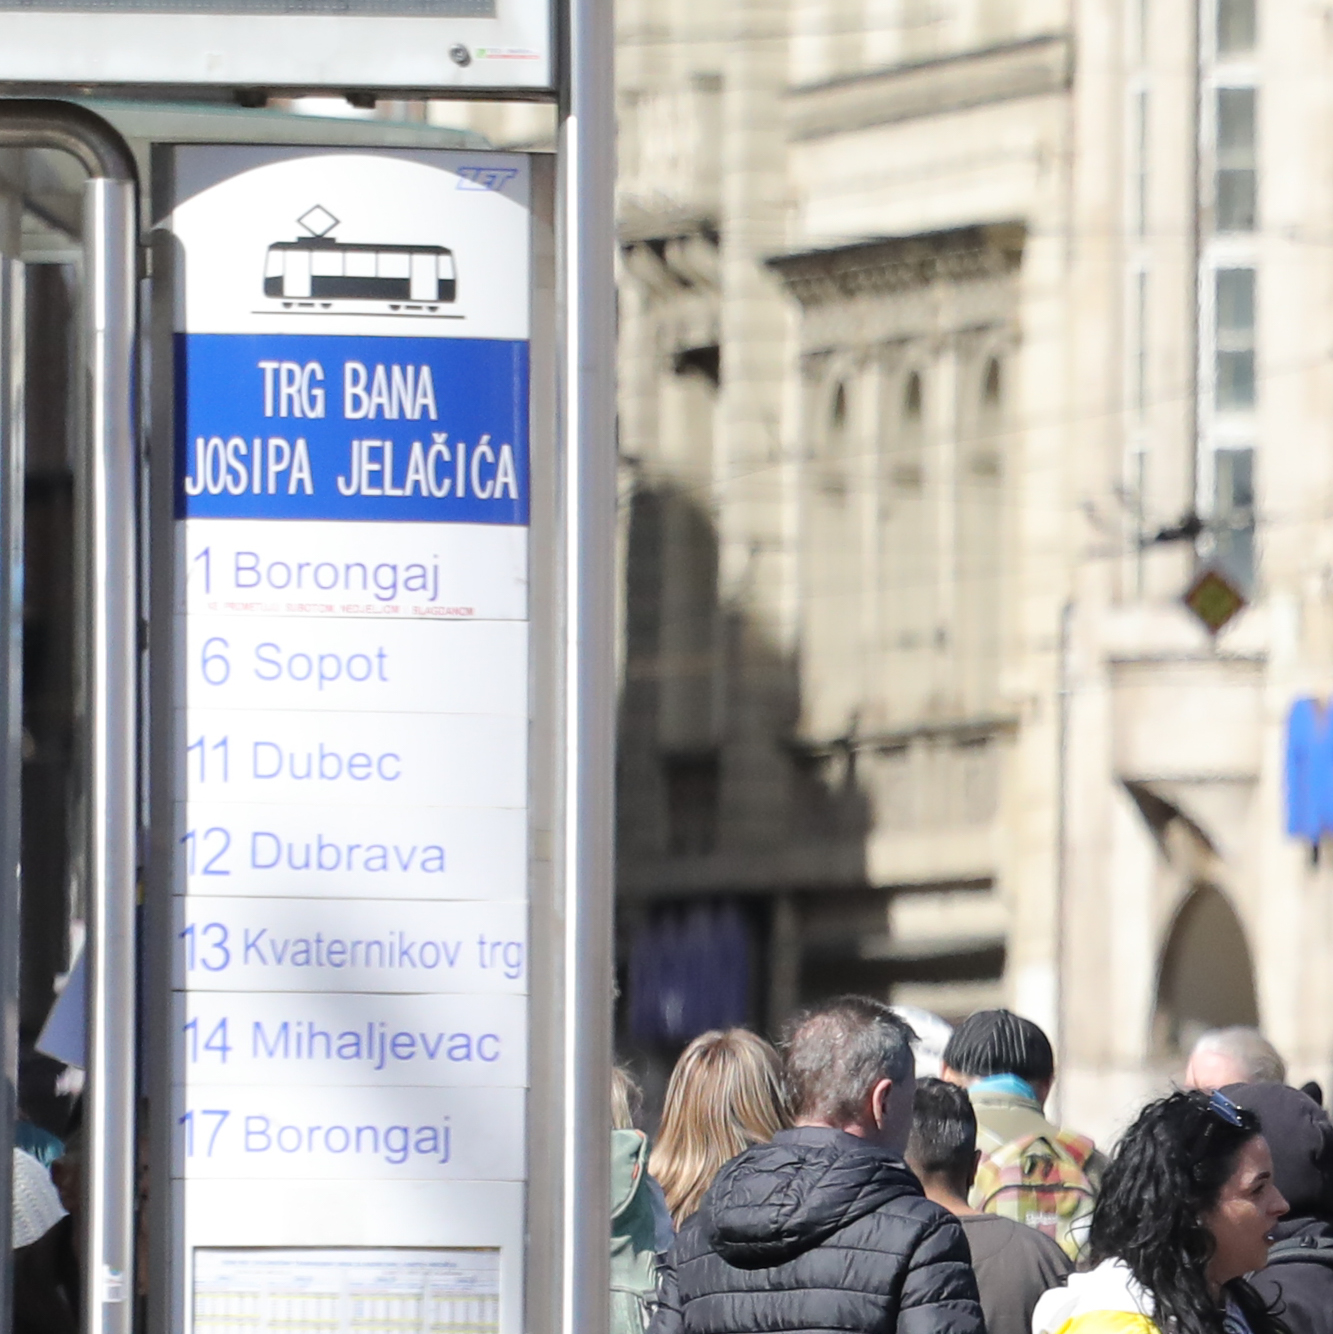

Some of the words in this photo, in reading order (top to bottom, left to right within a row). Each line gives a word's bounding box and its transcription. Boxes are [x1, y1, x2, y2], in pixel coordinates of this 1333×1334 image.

[257, 360, 325, 419] TRG
[343, 361, 438, 420] BANA
[186, 437, 314, 496] JOSIPA
[336, 432, 519, 500] JELAČIĆA
[193, 546, 212, 594] 1
[234, 551, 440, 602] Borongaj
[200, 636, 231, 687] 6
[253, 641, 389, 691] Sopot
[187, 735, 230, 783] 11
[252, 740, 402, 782] Dubec
[180, 827, 232, 876] 12
[249, 830, 447, 874] Dubrava
[179, 922, 231, 972] 13
[242, 927, 463, 972] Kvaternikov
[476, 935, 523, 980] trg
[181, 1016, 233, 1064] 14
[251, 1019, 502, 1071] Mihaljevac
[178, 1109, 231, 1158] 17
[244, 1115, 453, 1166] Borongaj
